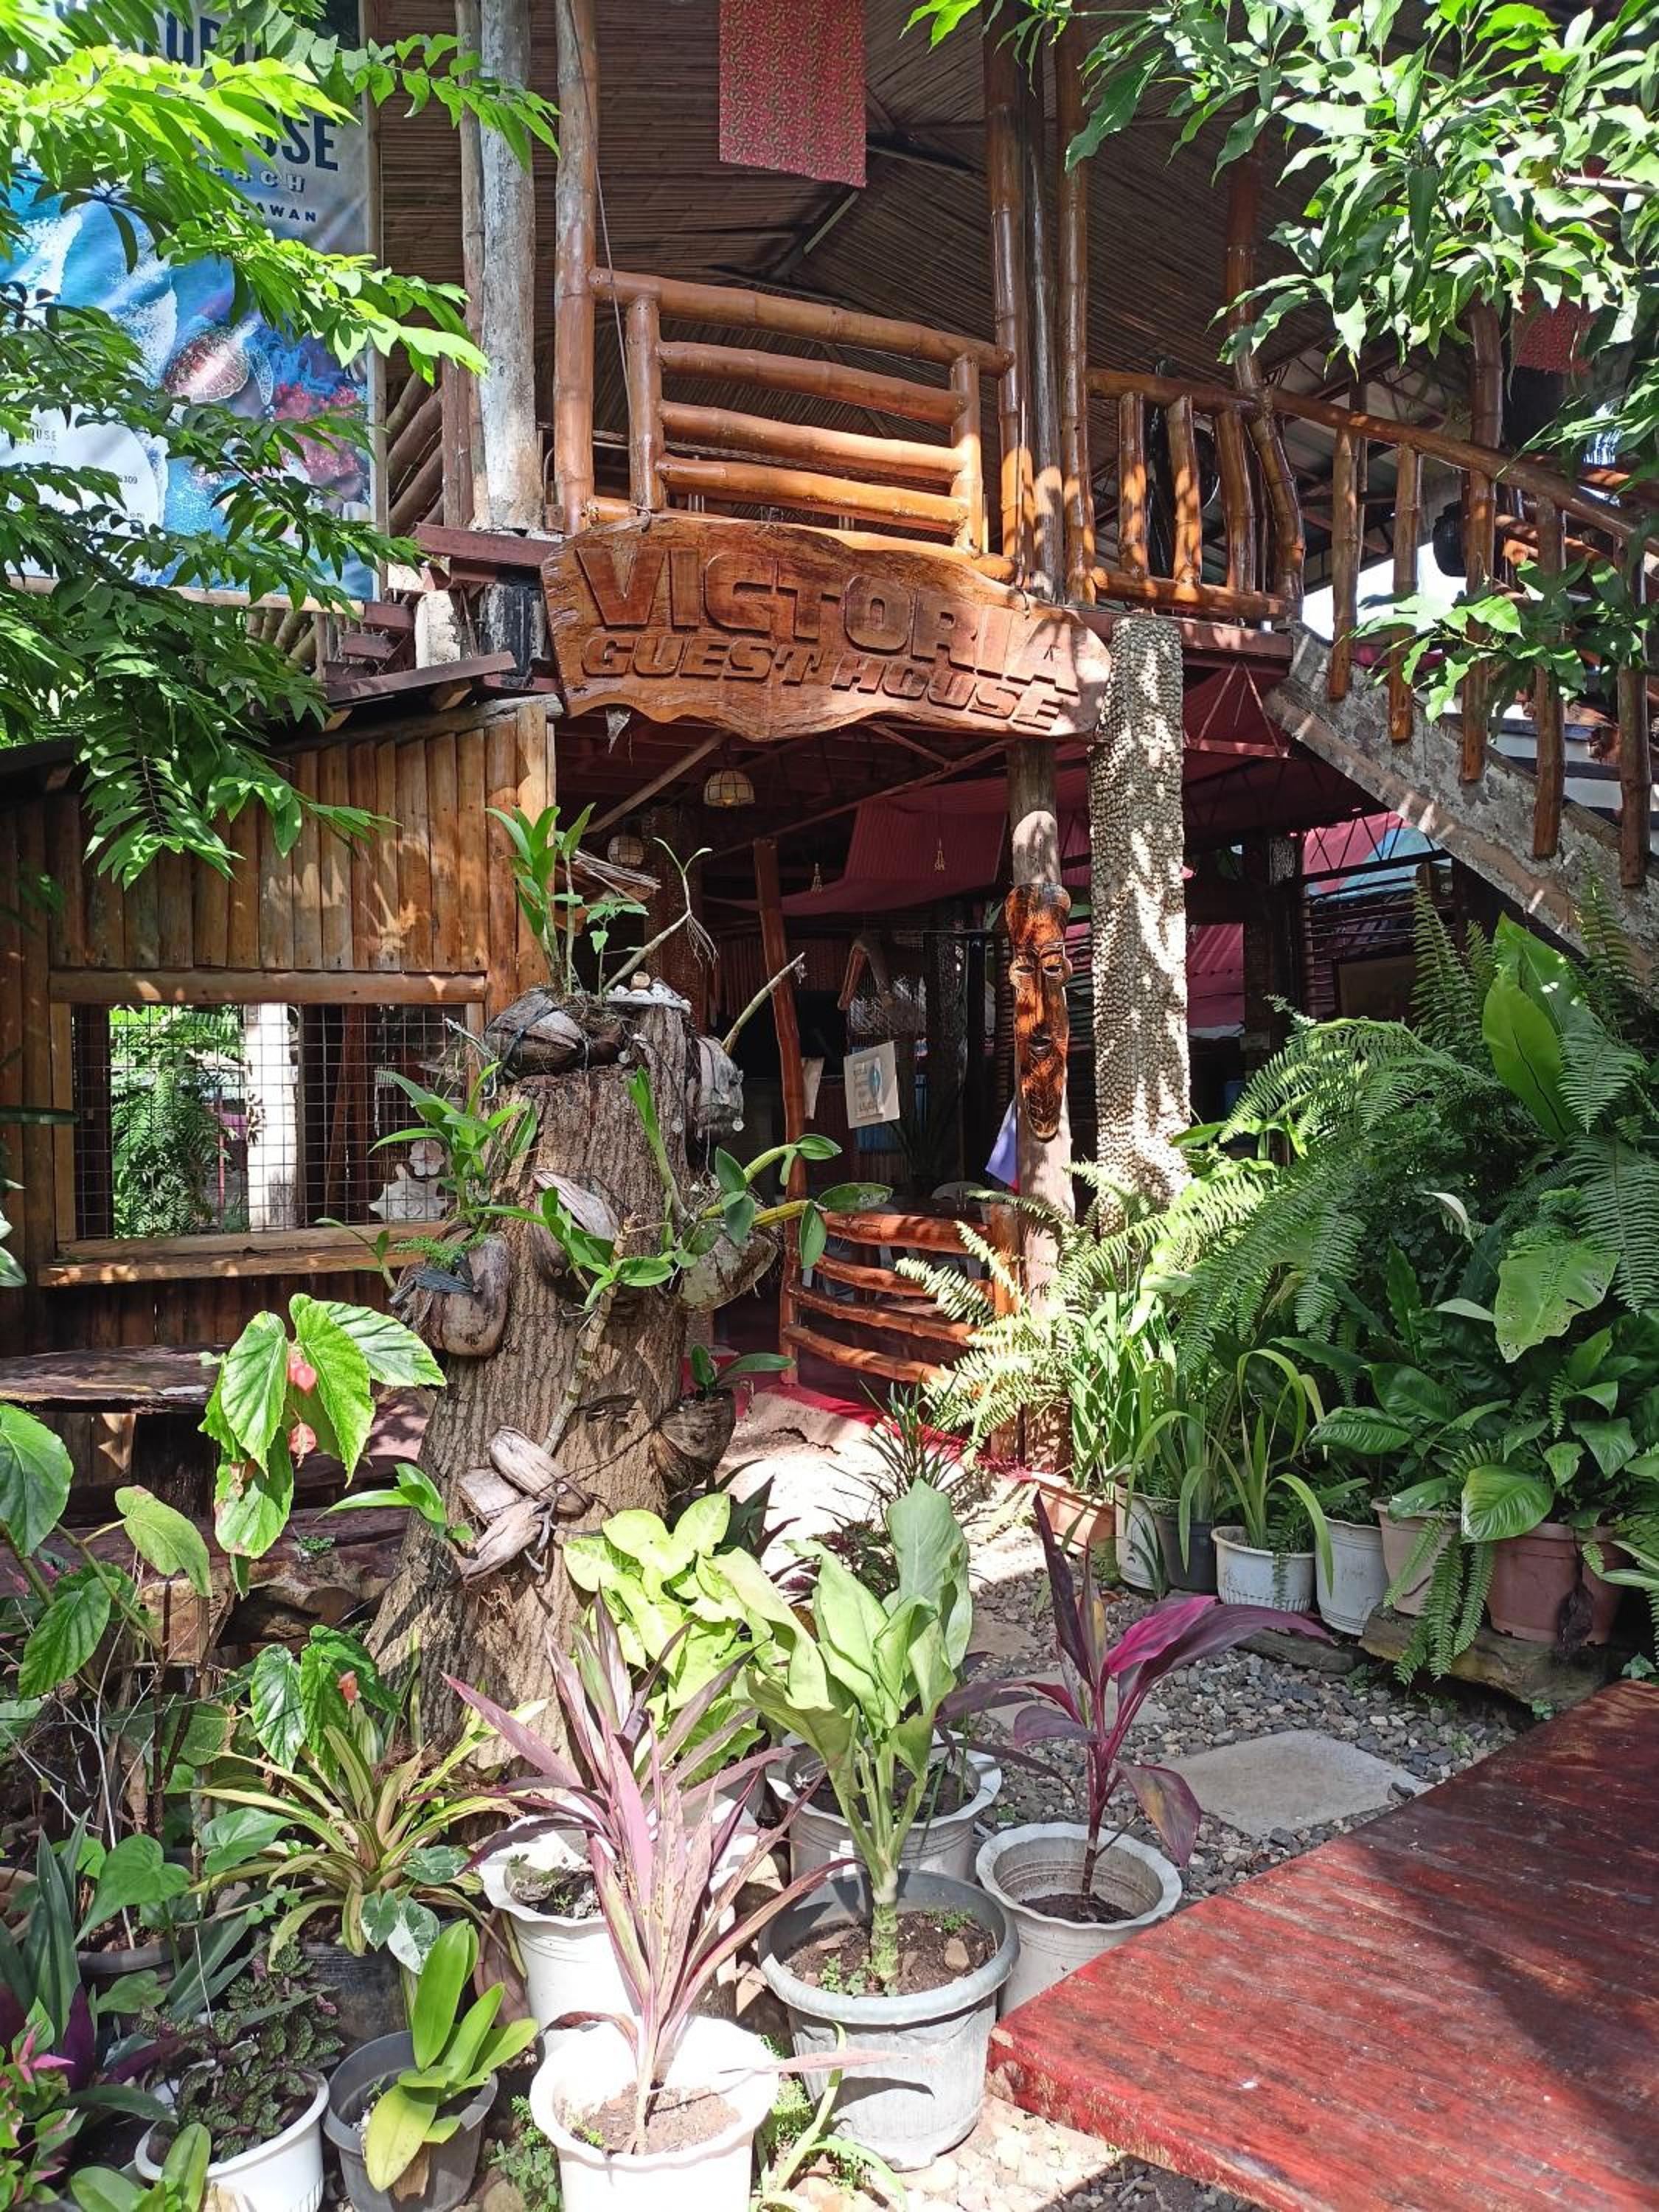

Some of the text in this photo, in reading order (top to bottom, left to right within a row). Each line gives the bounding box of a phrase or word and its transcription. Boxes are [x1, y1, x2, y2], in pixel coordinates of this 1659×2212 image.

[576, 547, 1079, 697] VICTORIA
[581, 635, 1063, 731] GUEST HOUSE
